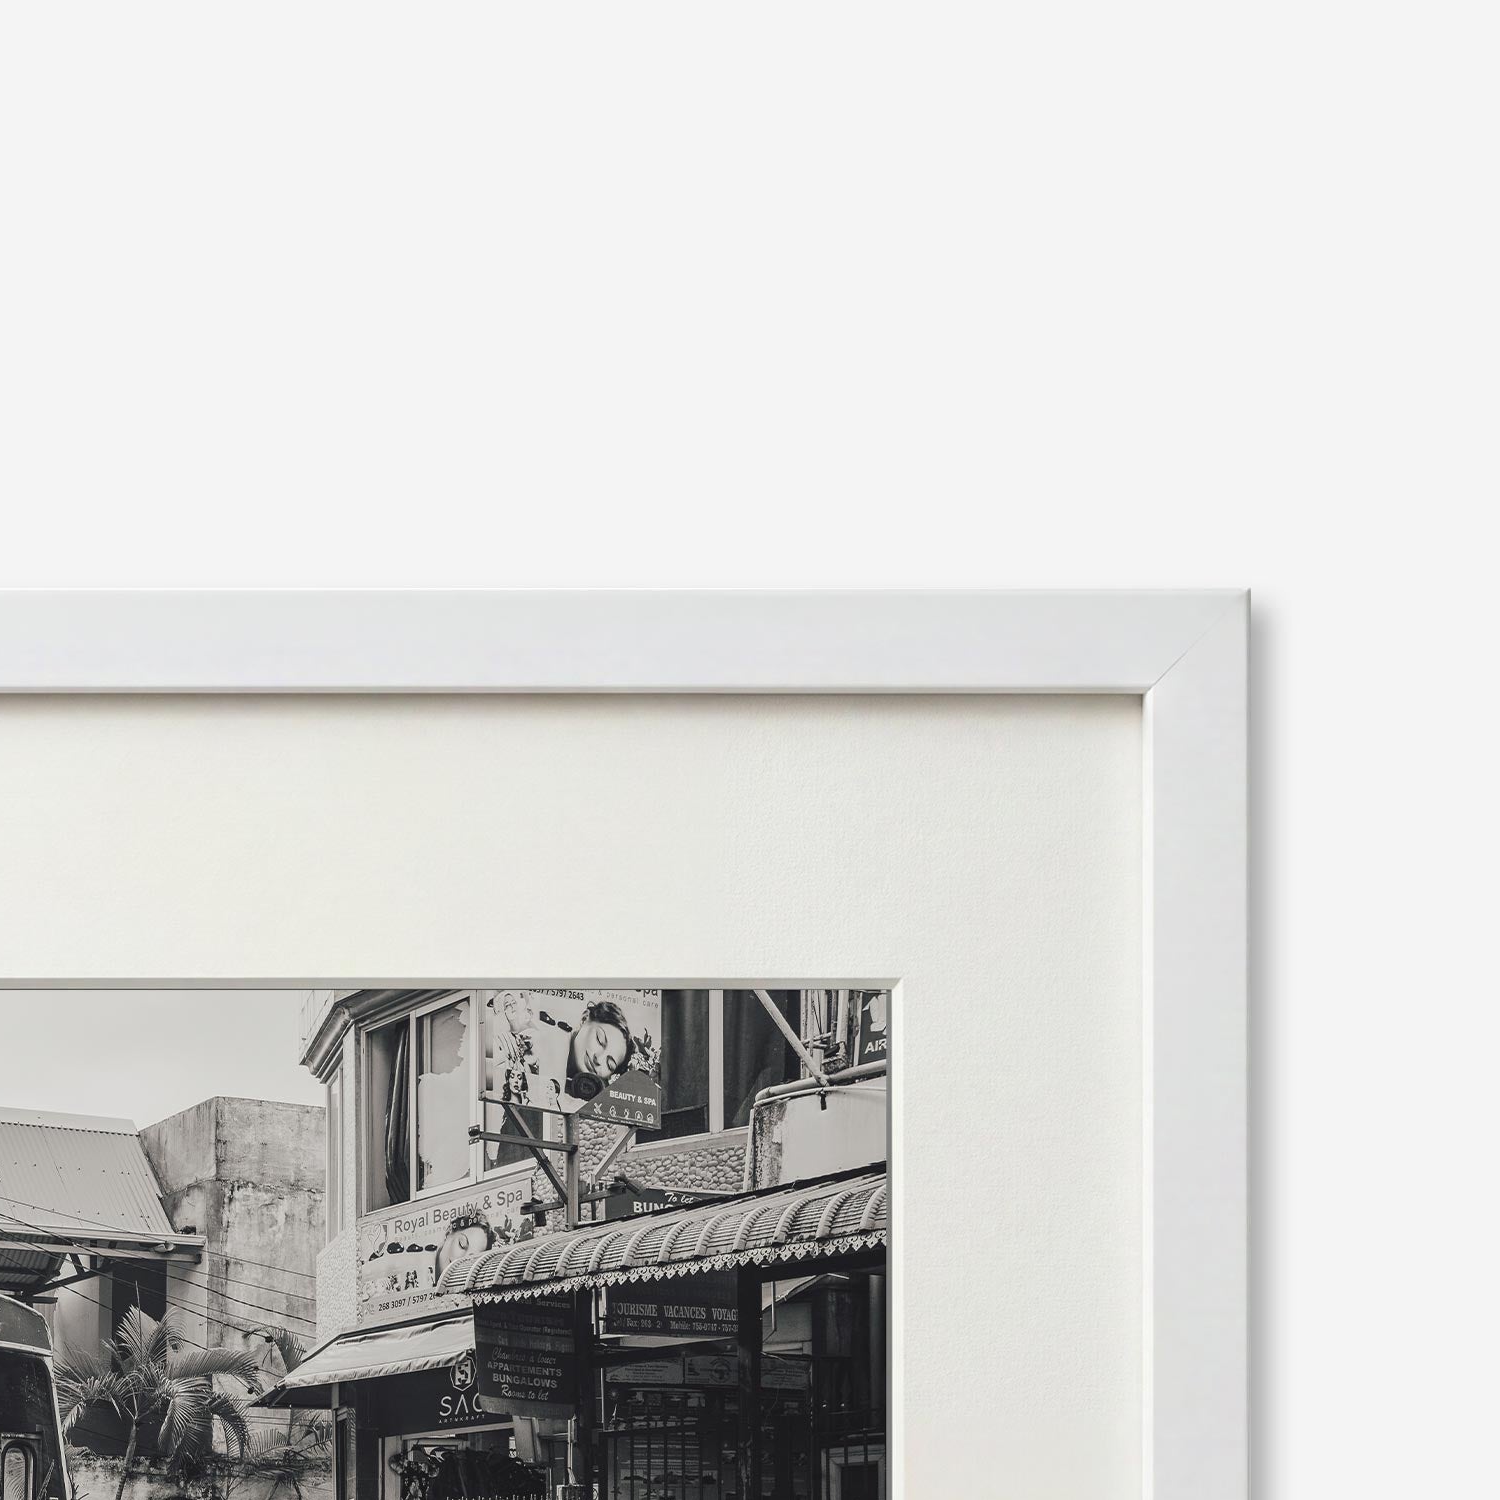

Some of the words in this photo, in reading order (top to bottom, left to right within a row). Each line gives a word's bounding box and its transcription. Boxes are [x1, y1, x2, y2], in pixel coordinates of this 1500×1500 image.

[568, 990, 585, 1001] 2643
[609, 1090, 637, 1103] BEAUTY
[638, 1095, 644, 1105] &
[644, 1097, 657, 1107] SPA
[664, 1192, 678, 1203] To
[680, 1195, 694, 1204] let
[394, 1211, 429, 1234] Royal
[433, 1201, 478, 1224] Beauty
[482, 1195, 492, 1210] &
[496, 1189, 523, 1208] Spa
[378, 1302, 390, 1312] 268
[391, 1298, 406, 1309] 3097
[412, 1293, 428, 1304] 5797
[536, 1299, 571, 1309] Services
[612, 1302, 658, 1317] TOURISME
[663, 1305, 707, 1320] VACANCES
[487, 1361, 563, 1377] APPARTEMENTS
[492, 1373, 559, 1389] BUNGALOWS
[527, 1390, 535, 1400] to
[537, 1389, 549, 1401] let
